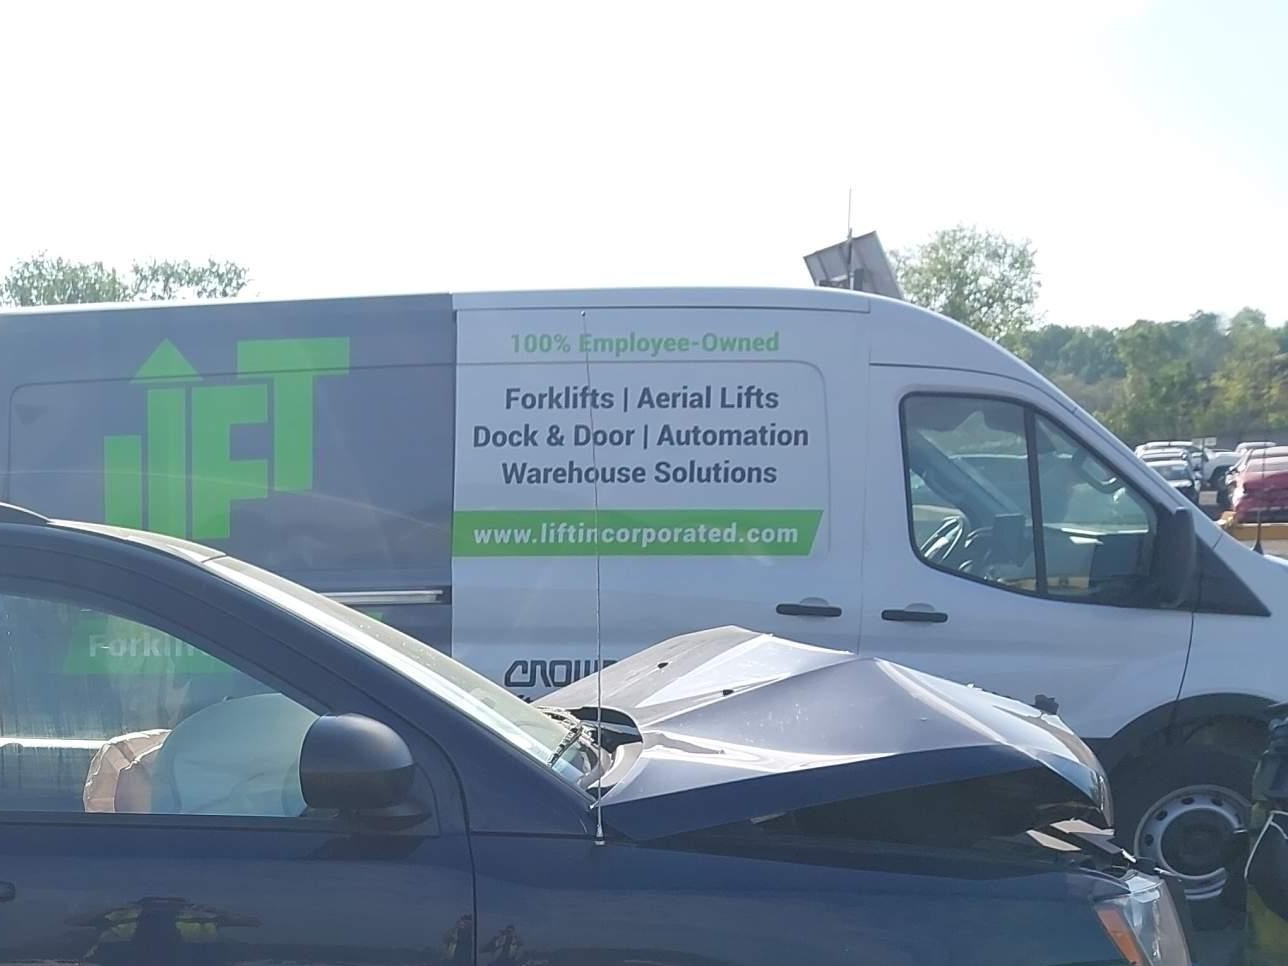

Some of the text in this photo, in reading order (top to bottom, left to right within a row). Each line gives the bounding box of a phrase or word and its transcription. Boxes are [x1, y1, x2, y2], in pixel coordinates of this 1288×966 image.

[512, 331, 781, 357] 100% Employee-Owned
[505, 385, 614, 410] Forklifts
[637, 385, 712, 409] Aerial
[720, 385, 780, 409] Lifts
[473, 423, 539, 448] Dock
[546, 424, 565, 447] &
[574, 424, 635, 447] Door
[656, 423, 810, 447] Automation
[502, 460, 778, 485] Warehouse Solutions
[473, 522, 799, 548] www.liftincorporated.com
